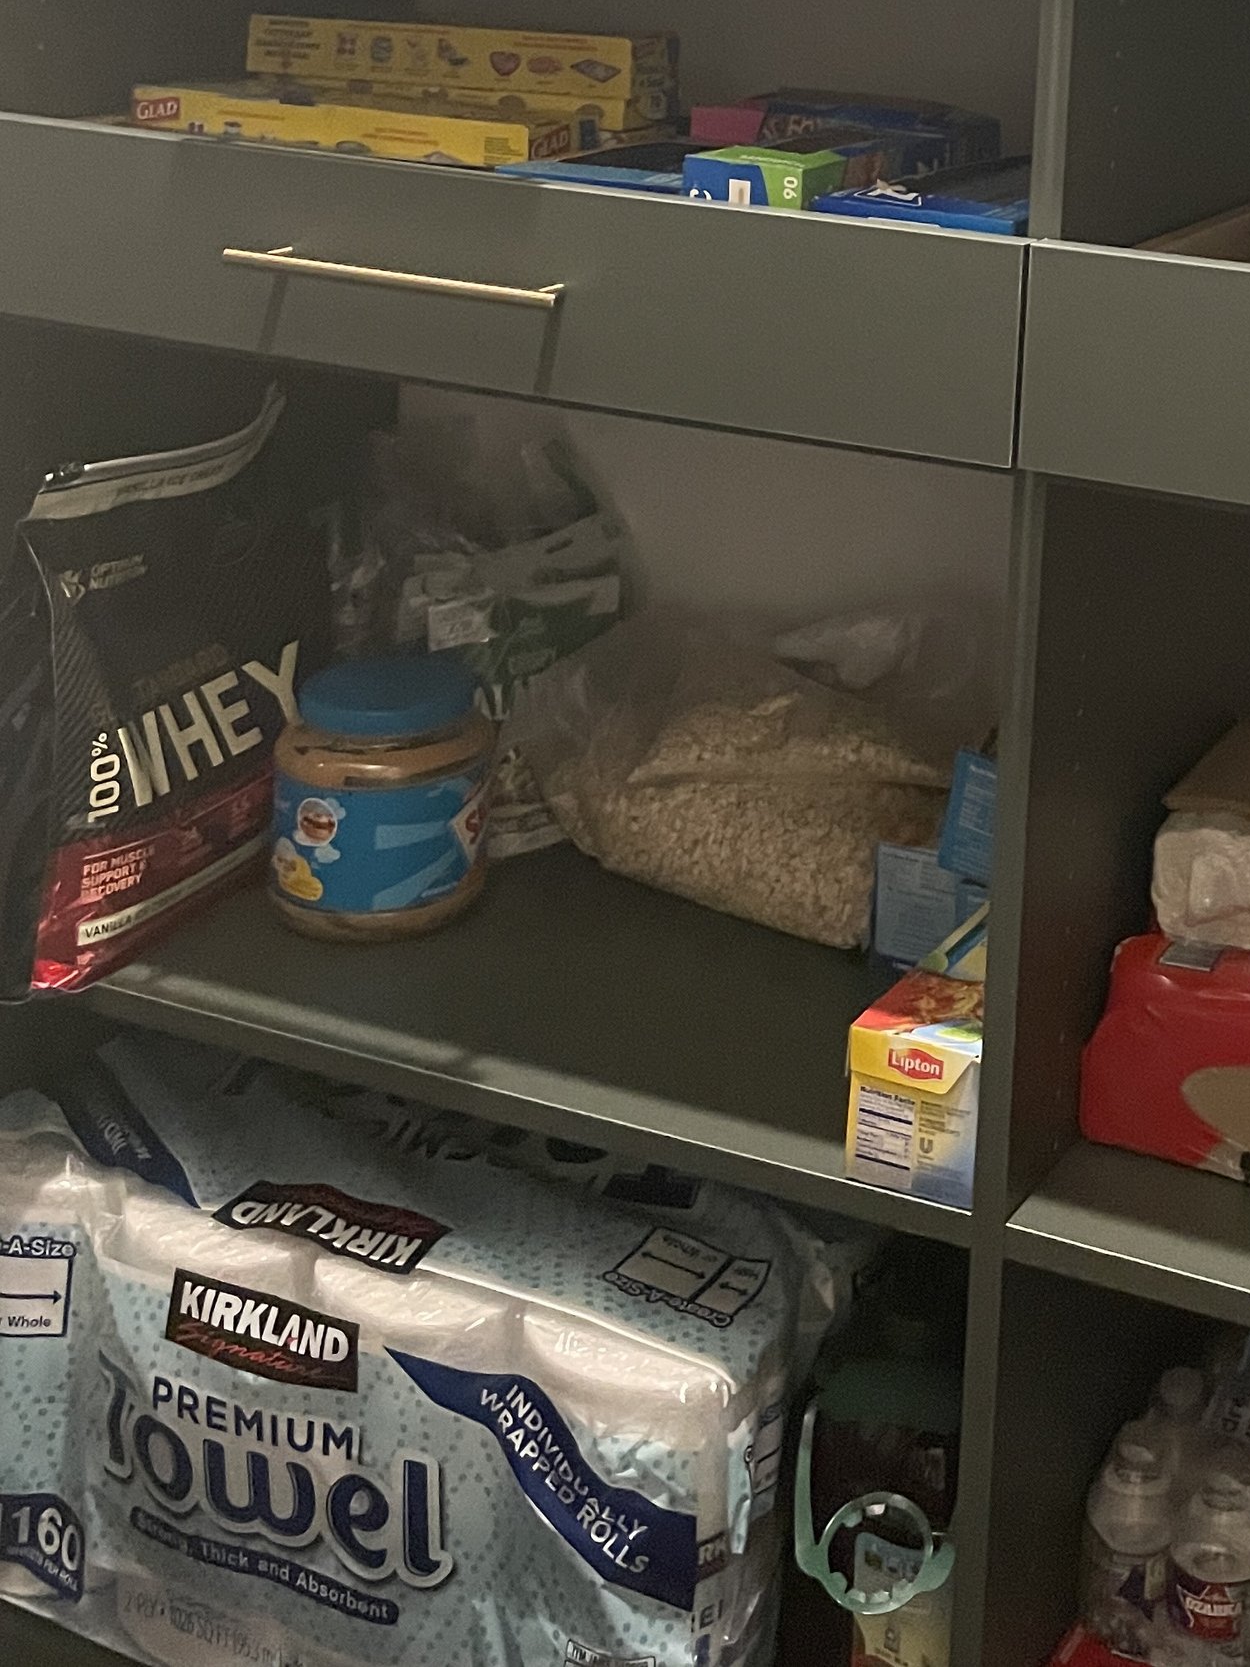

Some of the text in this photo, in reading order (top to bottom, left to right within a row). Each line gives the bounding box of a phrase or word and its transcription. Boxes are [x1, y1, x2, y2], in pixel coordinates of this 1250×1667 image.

[136, 100, 178, 122] GLAD
[530, 132, 570, 160] GLAD
[783, 176, 799, 200] 90
[117, 640, 299, 808] WHEY
[87, 732, 121, 823] 100%
[85, 915, 132, 938] VANILLA
[890, 1050, 940, 1076] Lipton
[231, 1199, 424, 1267] KIRKLAND
[7, 1315, 52, 1328] Whole
[179, 1280, 350, 1364] KIRKLAND
[152, 1376, 355, 1462] PREMIUM
[480, 1389, 576, 1506] WRAPPED
[576, 1508, 651, 1575] ROLLS
[506, 1384, 650, 1543] INDIVIDUALLY
[10, 1505, 81, 1572] 160
[202, 1540, 389, 1620] Thick and Absorbent
